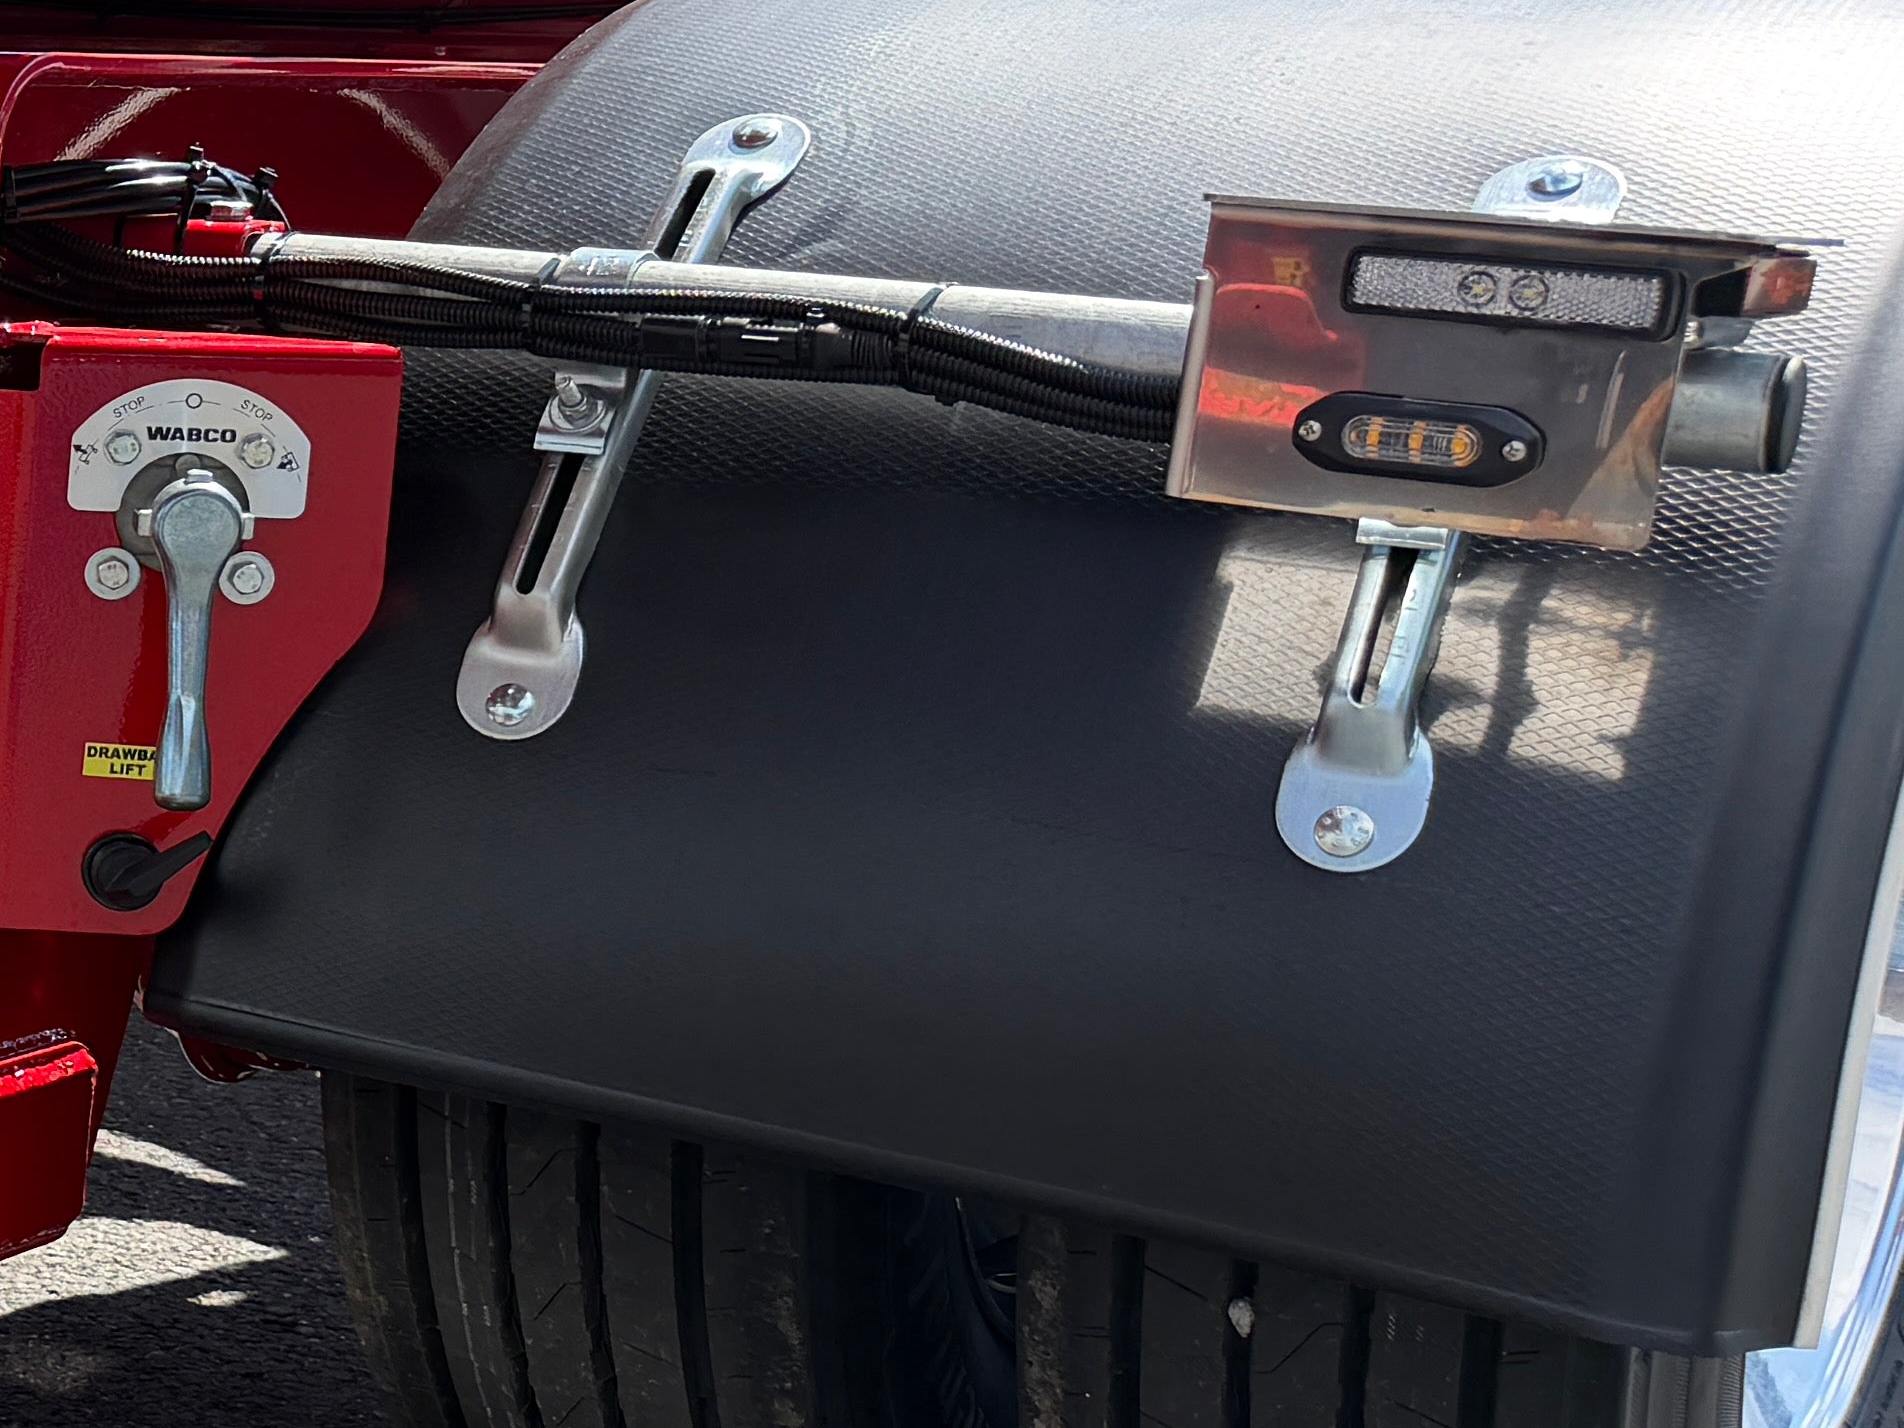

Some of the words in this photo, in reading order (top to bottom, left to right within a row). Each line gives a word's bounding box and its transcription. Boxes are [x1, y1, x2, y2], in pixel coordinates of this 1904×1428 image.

[112, 396, 145, 418] STOP
[241, 399, 273, 422] STOP
[146, 426, 237, 444] WABCO
[87, 746, 157, 762] DRAWBA
[109, 763, 147, 777] LIFT
